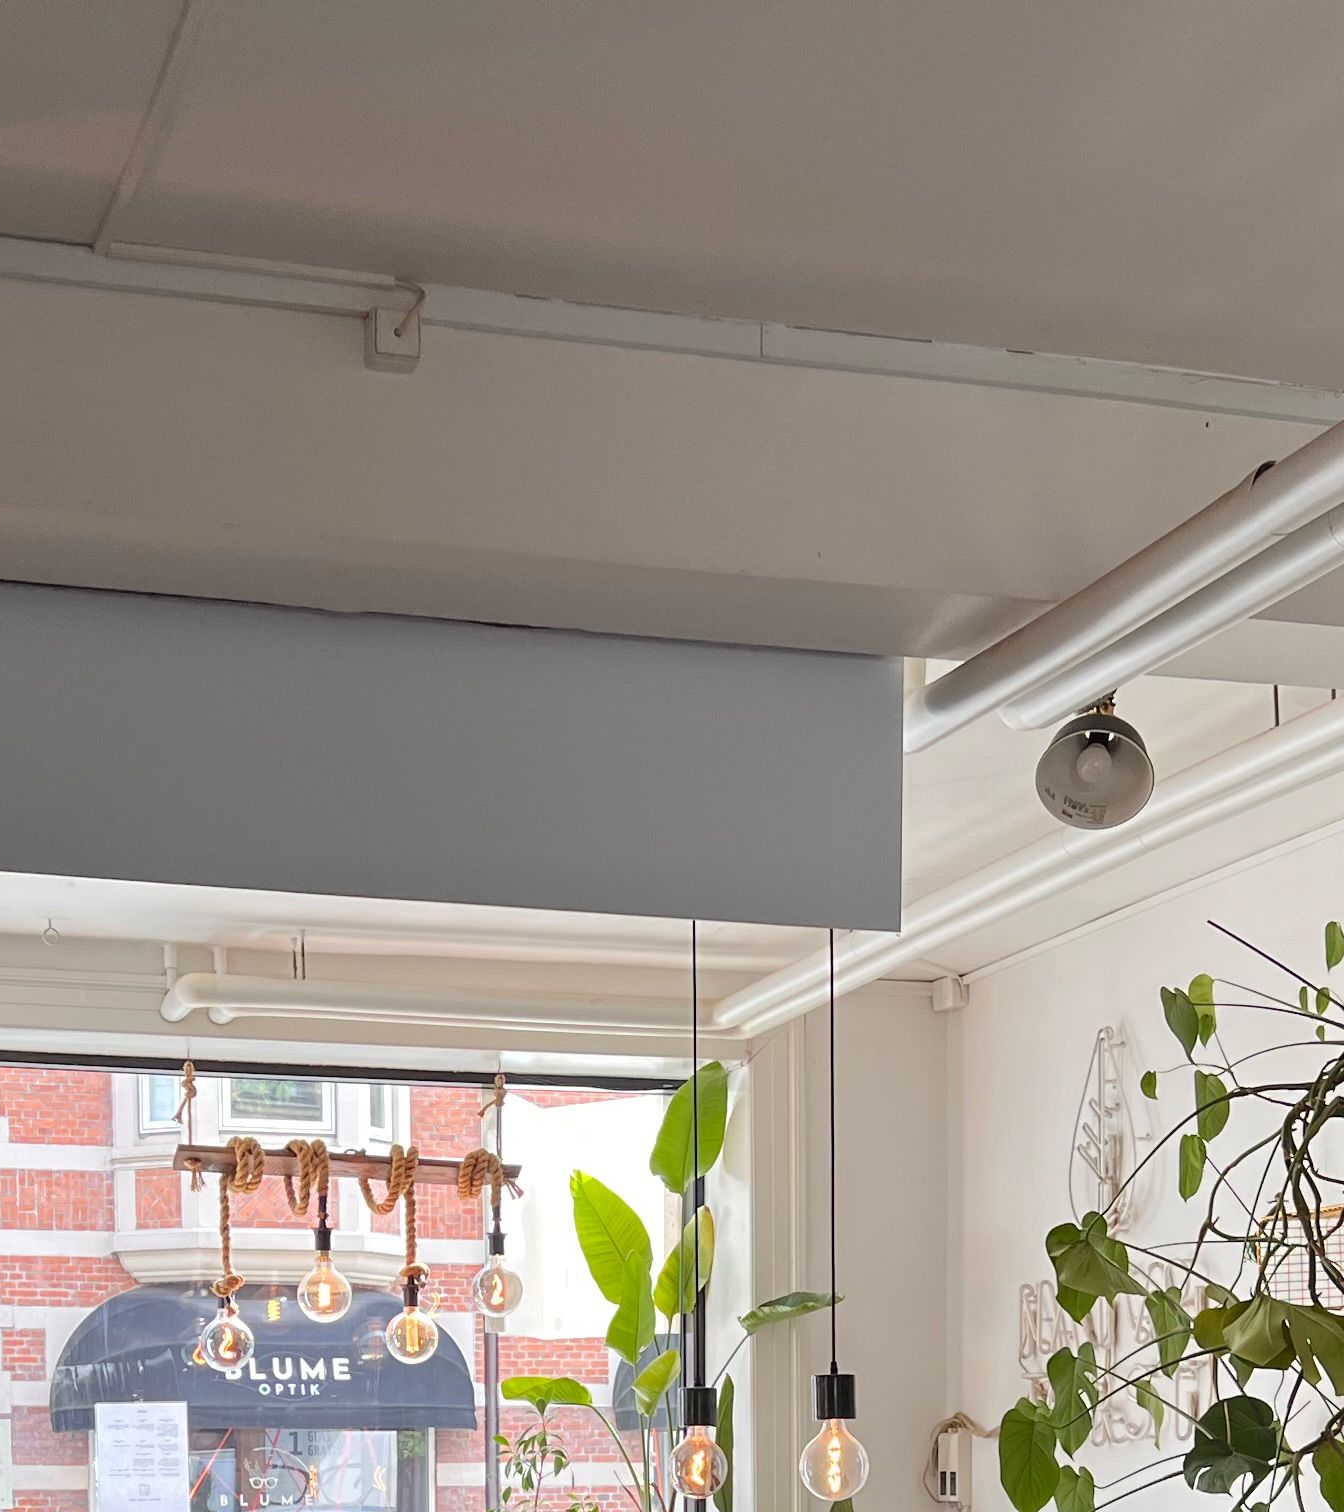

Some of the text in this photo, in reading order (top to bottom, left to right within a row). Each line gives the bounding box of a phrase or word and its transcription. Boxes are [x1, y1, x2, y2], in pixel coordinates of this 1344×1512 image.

[225, 1357, 351, 1381] BLUME
[258, 1383, 321, 1396] OPTIK
[219, 1494, 316, 1508] BLUME
